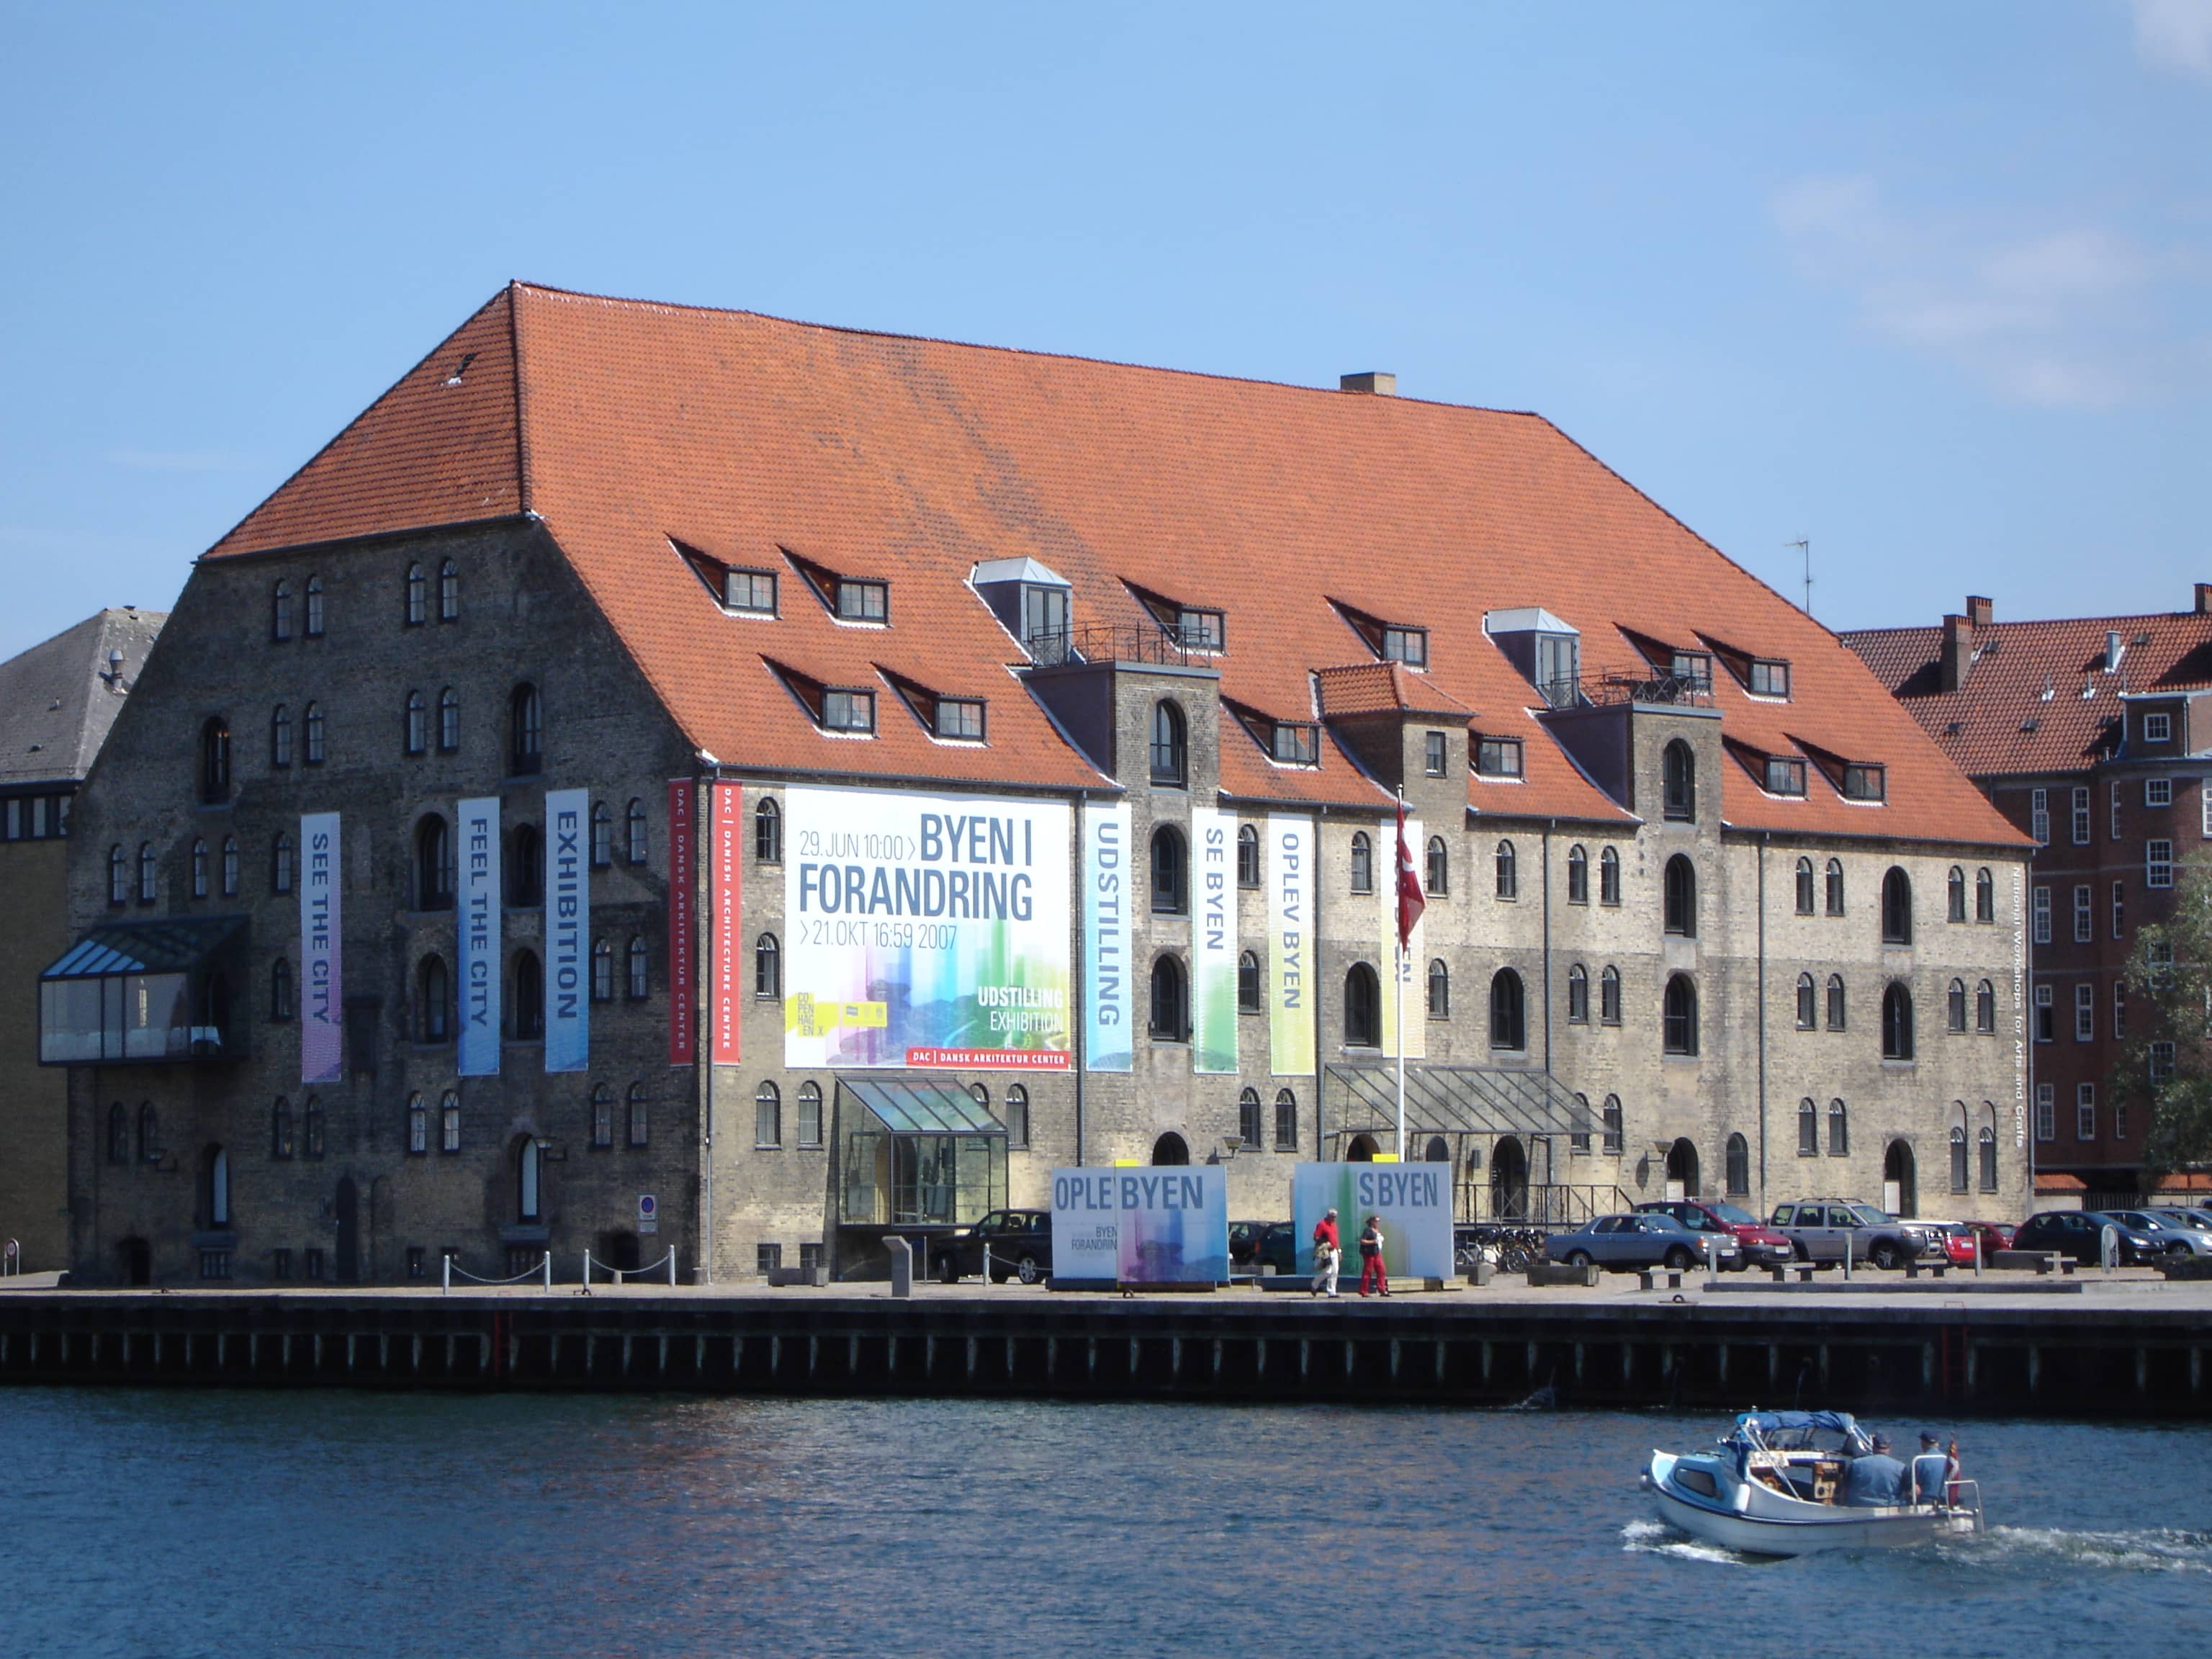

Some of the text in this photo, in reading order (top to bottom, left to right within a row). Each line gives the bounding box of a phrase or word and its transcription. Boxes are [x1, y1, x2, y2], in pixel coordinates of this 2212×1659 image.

[863, 834, 903, 860] 10:00
[920, 813, 1014, 866] BYEN
[1025, 819, 1032, 866] I
[557, 811, 578, 1019] EXHIBITION
[800, 863, 1032, 921] FORANDRING
[1205, 828, 1224, 950] SE BYEN
[312, 833, 329, 1024] SEE THE CITY
[471, 818, 487, 1026] FEEL THE CITY
[873, 922, 913, 948] 16:59
[918, 924, 957, 950] 2007
[1097, 822, 1120, 1026] UDSTILLING
[1282, 832, 1300, 1009] OPLEV BYEN
[978, 986, 1064, 1008] UDSTILLING
[2013, 930, 2023, 1009] Workshops
[990, 1011, 1064, 1032] EXHIBITION
[913, 1052, 1065, 1064] DAC DANSK ARKITEKTUR CENTER
[2016, 1105, 2025, 1148] Crafts
[1121, 1175, 1203, 1210] BYEN
[1378, 1172, 1438, 1207] BYEN
